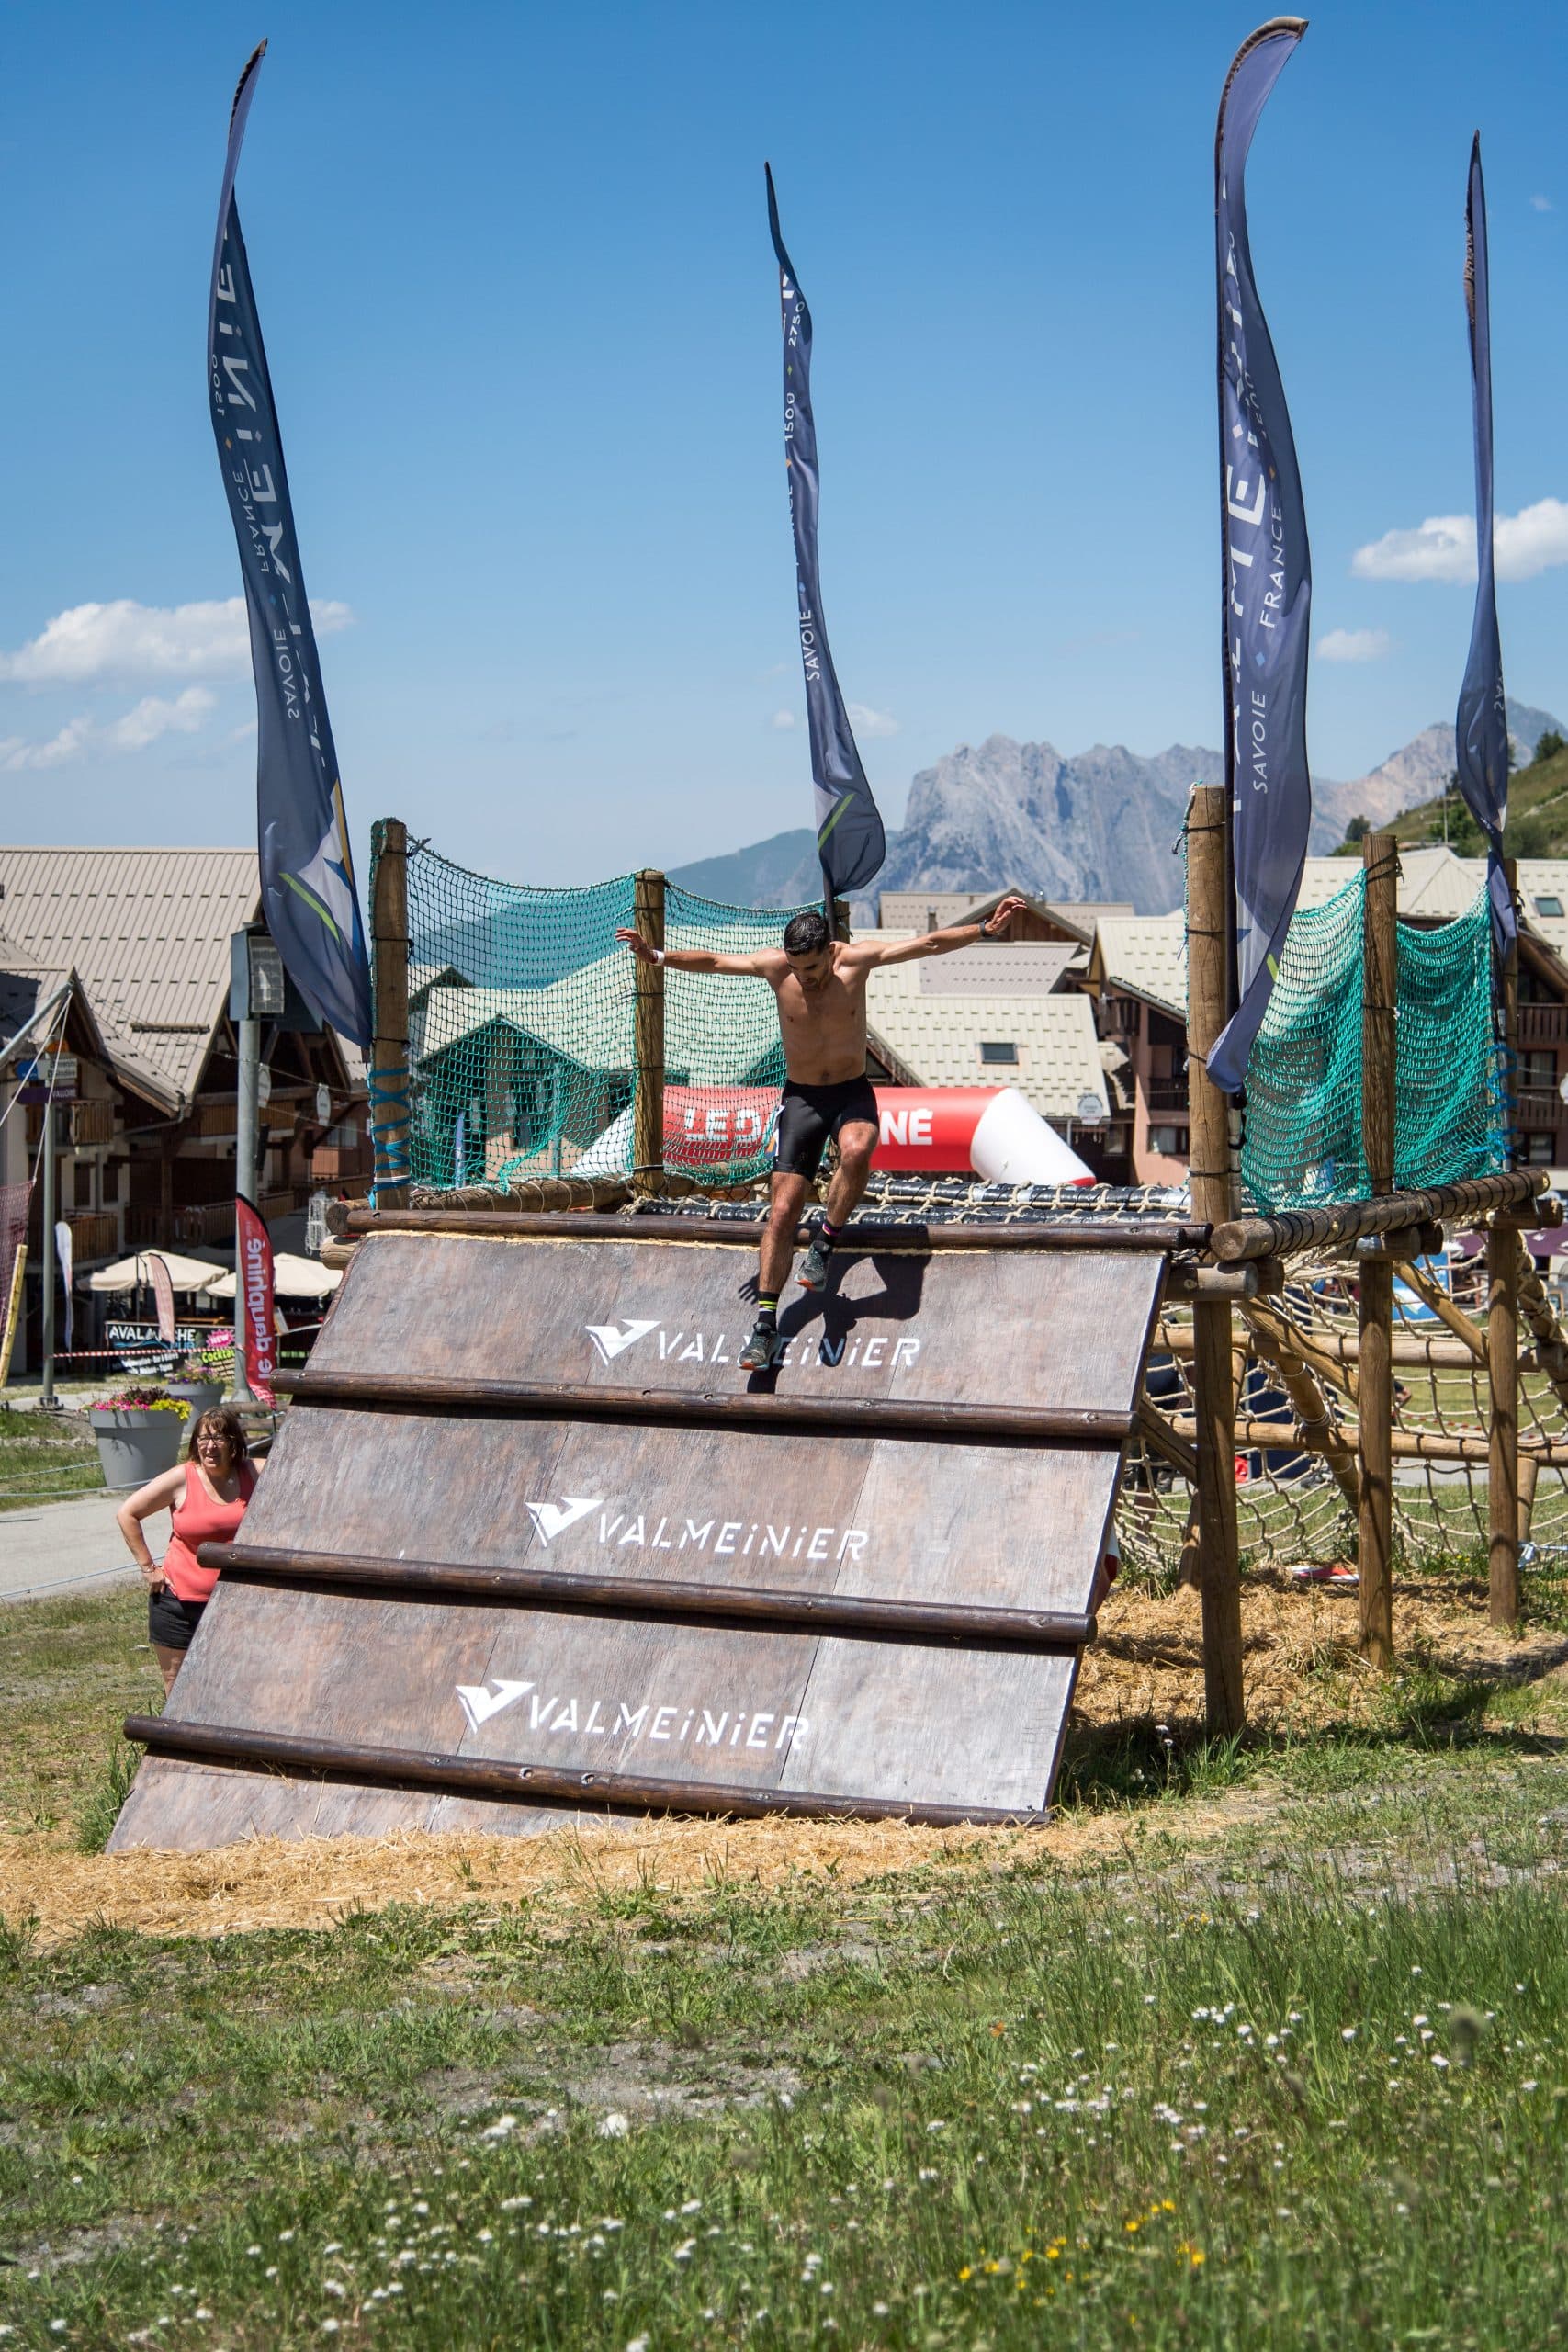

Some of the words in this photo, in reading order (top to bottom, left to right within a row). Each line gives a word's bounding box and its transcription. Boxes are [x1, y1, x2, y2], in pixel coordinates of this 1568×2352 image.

[788, 301, 805, 346] 2750
[784, 392, 795, 441] 1500
[1259, 506, 1286, 628] FRANCE
[799, 609, 820, 680] SAVOIE
[1251, 690, 1268, 794] SAVOIE
[109, 1325, 196, 1341] AVALAHE
